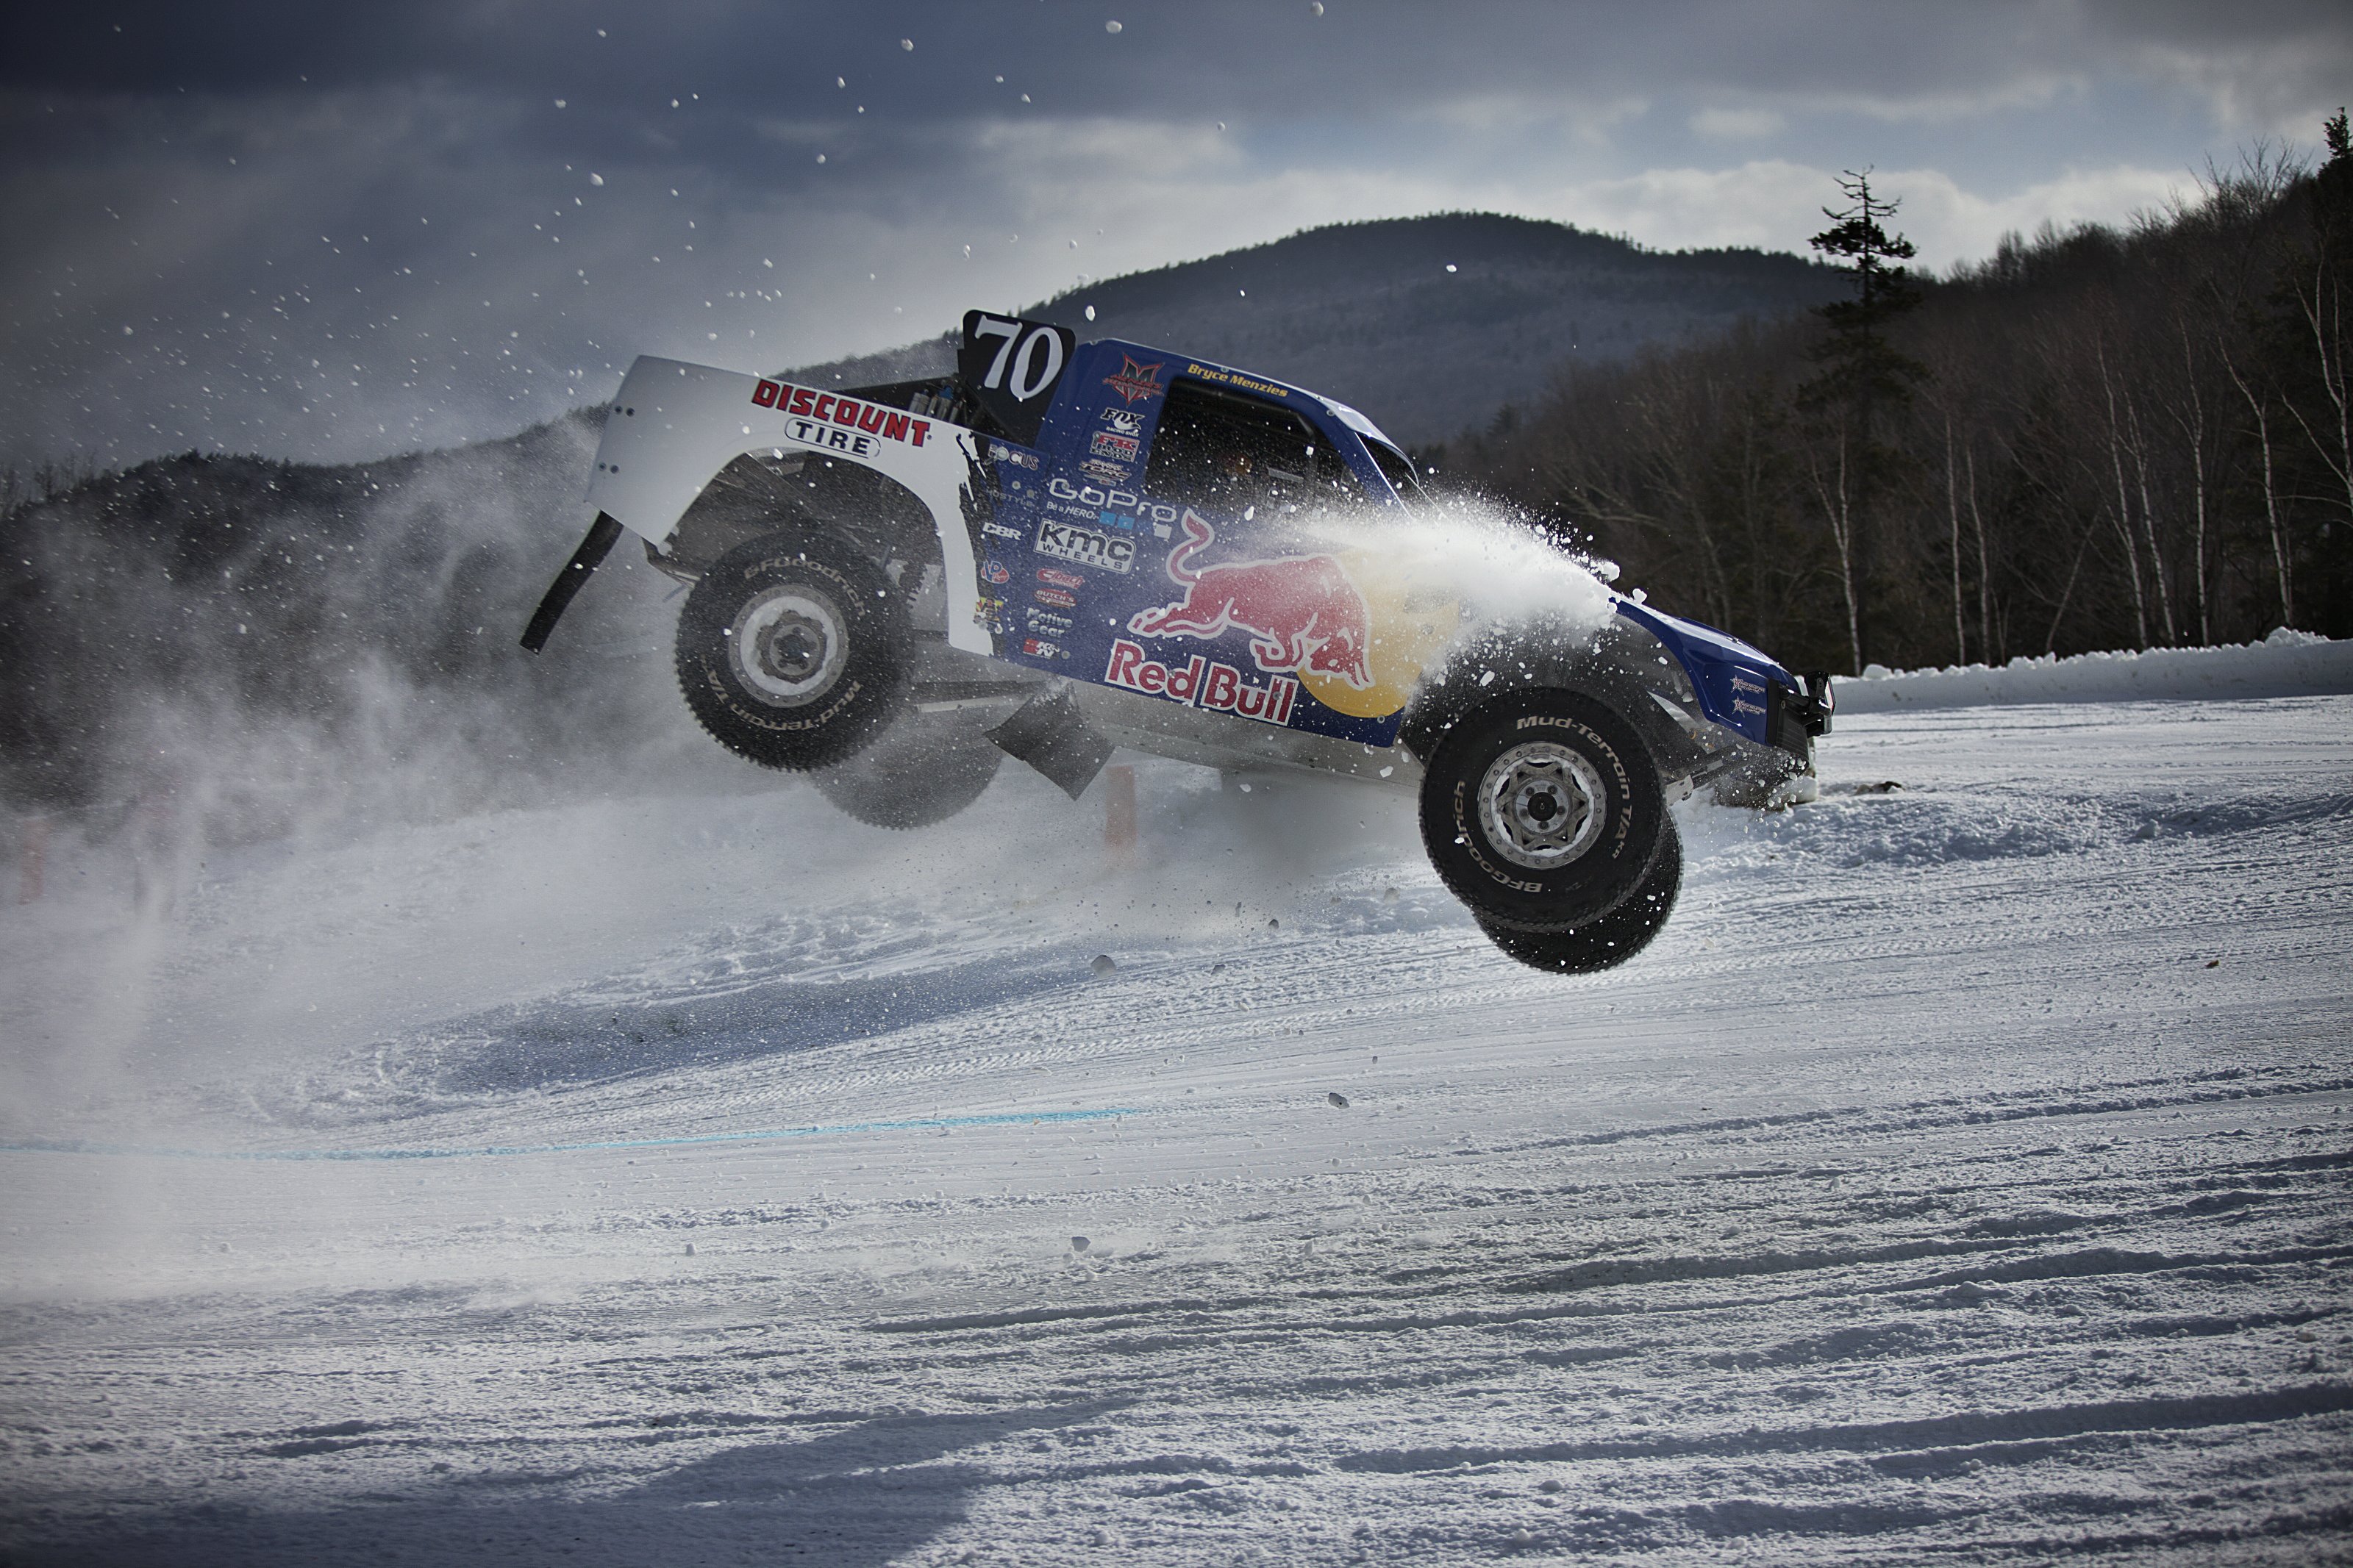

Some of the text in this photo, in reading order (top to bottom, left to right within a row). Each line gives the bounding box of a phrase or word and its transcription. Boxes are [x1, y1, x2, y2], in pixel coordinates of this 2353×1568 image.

[974, 315, 1063, 399] 70
[1188, 363, 1288, 398] Bryce Menzies
[751, 379, 930, 447] DISCOUNT
[1100, 407, 1146, 426] FOX
[794, 420, 871, 455] TIRE
[1046, 501, 1058, 511] Be
[1049, 478, 1177, 523] GoPro
[1043, 543, 1124, 570] WHEELS
[743, 556, 865, 616] BFGoodrich
[1026, 607, 1073, 629] Motive
[1028, 620, 1065, 638] Gear
[1106, 640, 1297, 725] Red Bull
[729, 681, 863, 731] Mud-Terrain
[1516, 715, 1630, 800] Mud-Terrain
[1615, 805, 1632, 839] T/A
[1454, 780, 1543, 892] BFGoodrich
